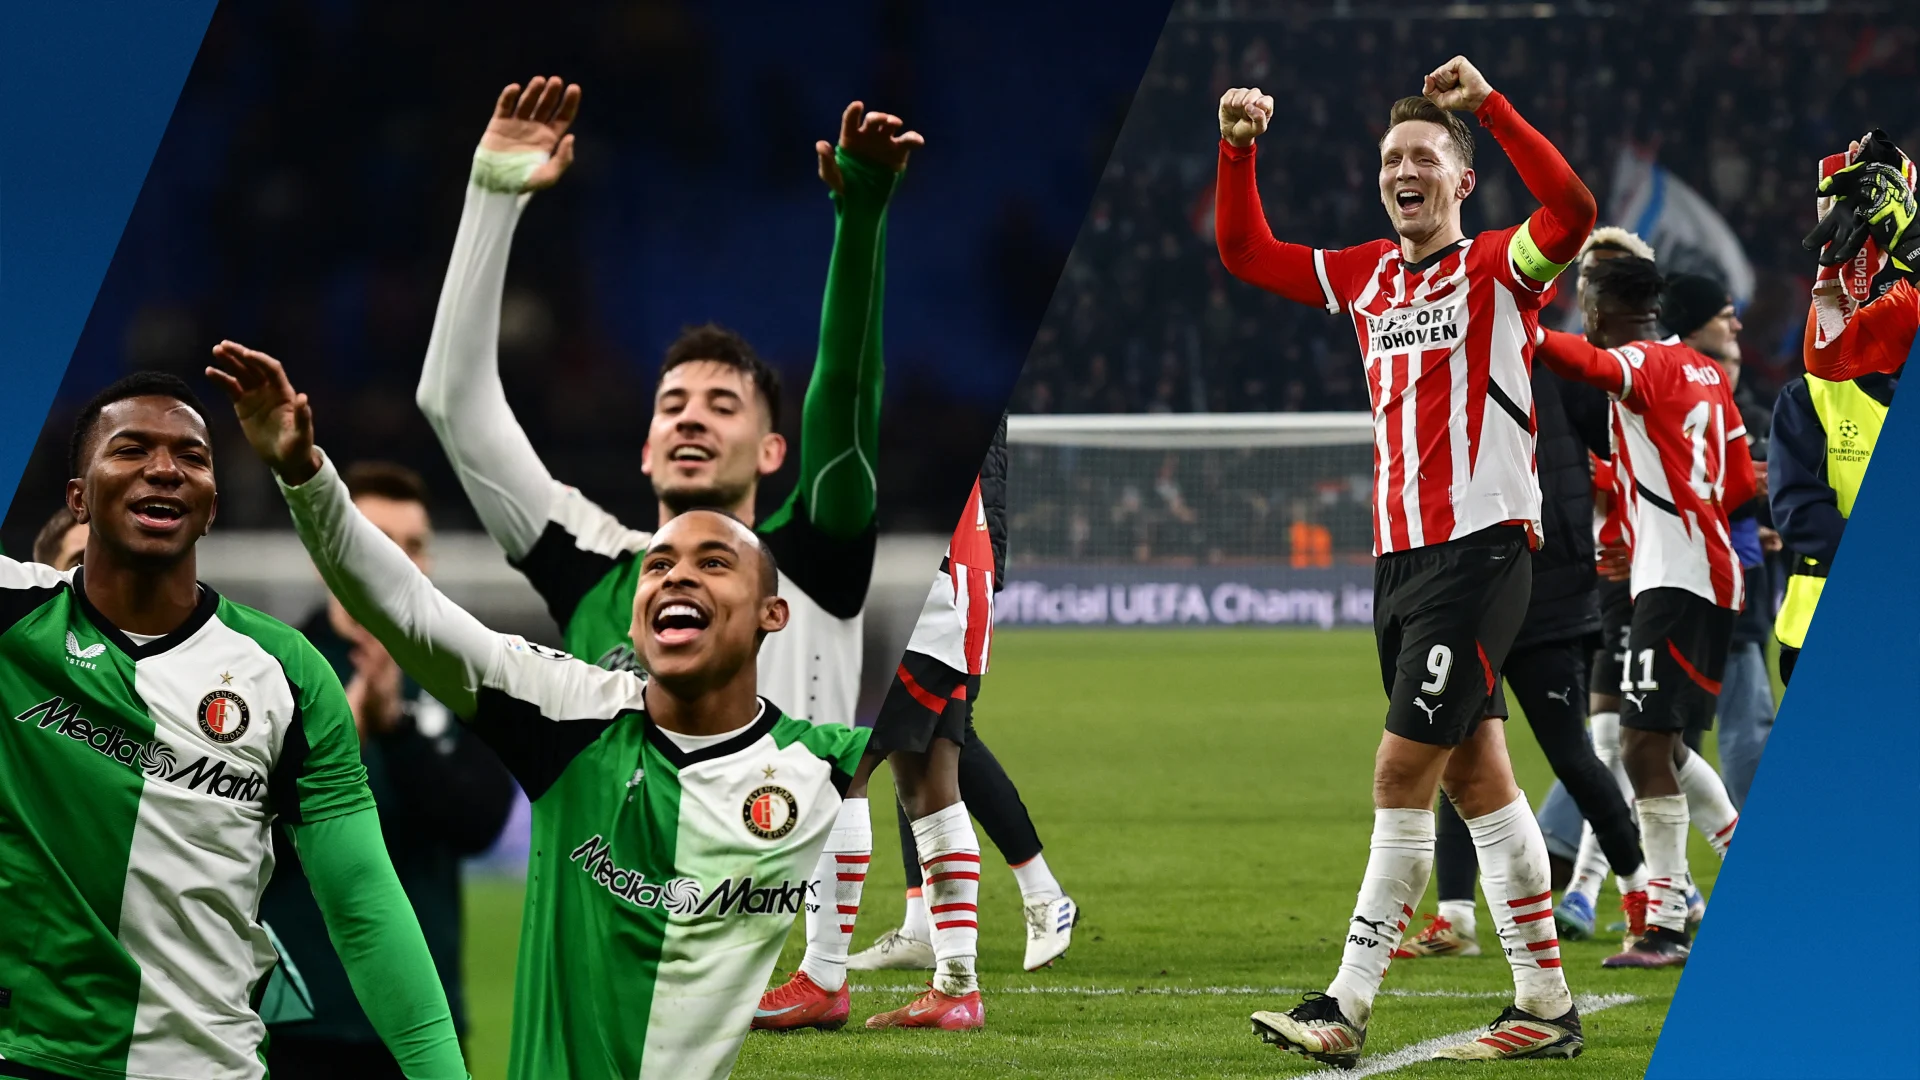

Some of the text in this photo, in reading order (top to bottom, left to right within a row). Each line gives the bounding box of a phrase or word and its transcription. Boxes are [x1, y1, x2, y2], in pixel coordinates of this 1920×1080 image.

[1829, 448, 1870, 457] CHAMPIONS
[1836, 454, 1863, 462] LEAGUE
[1111, 583, 1210, 624] UEFA
[1421, 644, 1454, 696] 9
[1620, 648, 1659, 692] 11
[202, 691, 248, 712] FEYENOORD
[14, 695, 142, 767] Media
[200, 719, 246, 741] ROTTERDAM
[745, 817, 795, 839] ROTTERDAM
[569, 833, 663, 909] Media
[1348, 934, 1379, 949] PSV
